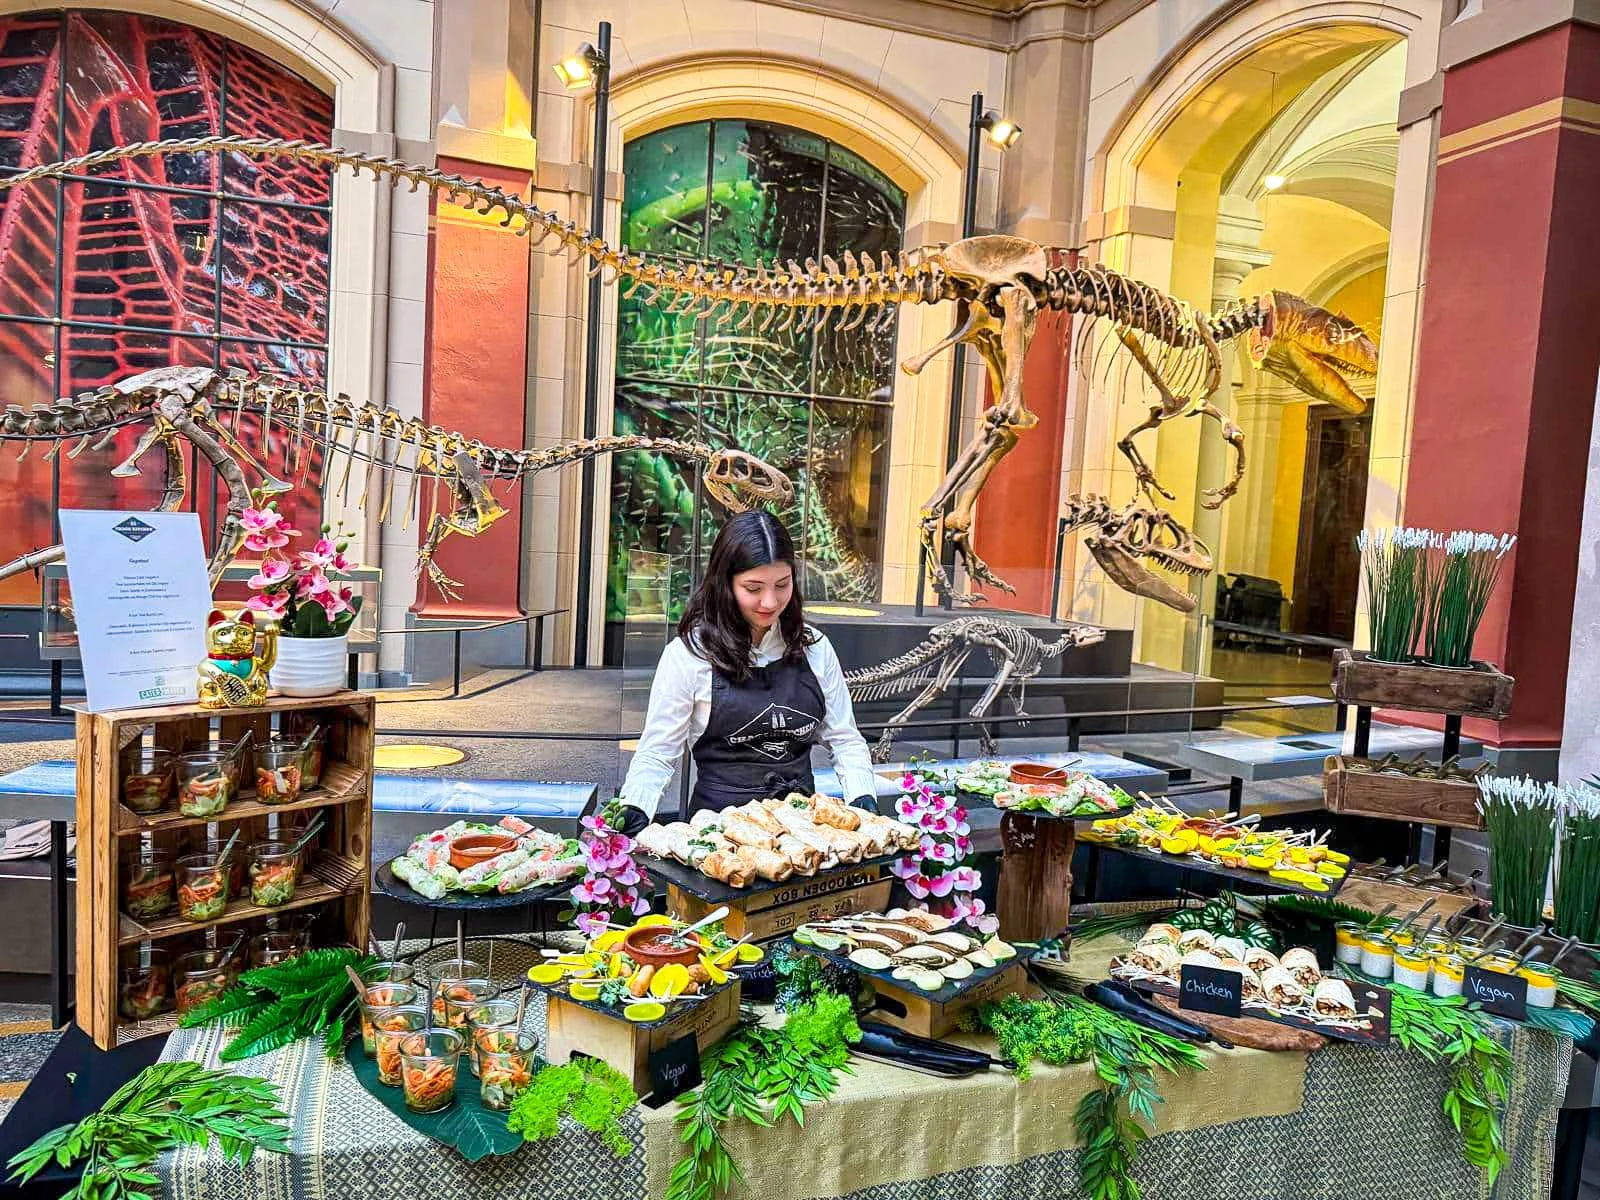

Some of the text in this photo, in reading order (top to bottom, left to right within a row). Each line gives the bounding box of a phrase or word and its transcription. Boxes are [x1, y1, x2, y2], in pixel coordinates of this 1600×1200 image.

[772, 889, 799, 905] BOX
[1185, 979, 1233, 1000] Chicken
[1470, 975, 1516, 1001] Vegan
[661, 1063, 688, 1088] Vegan
